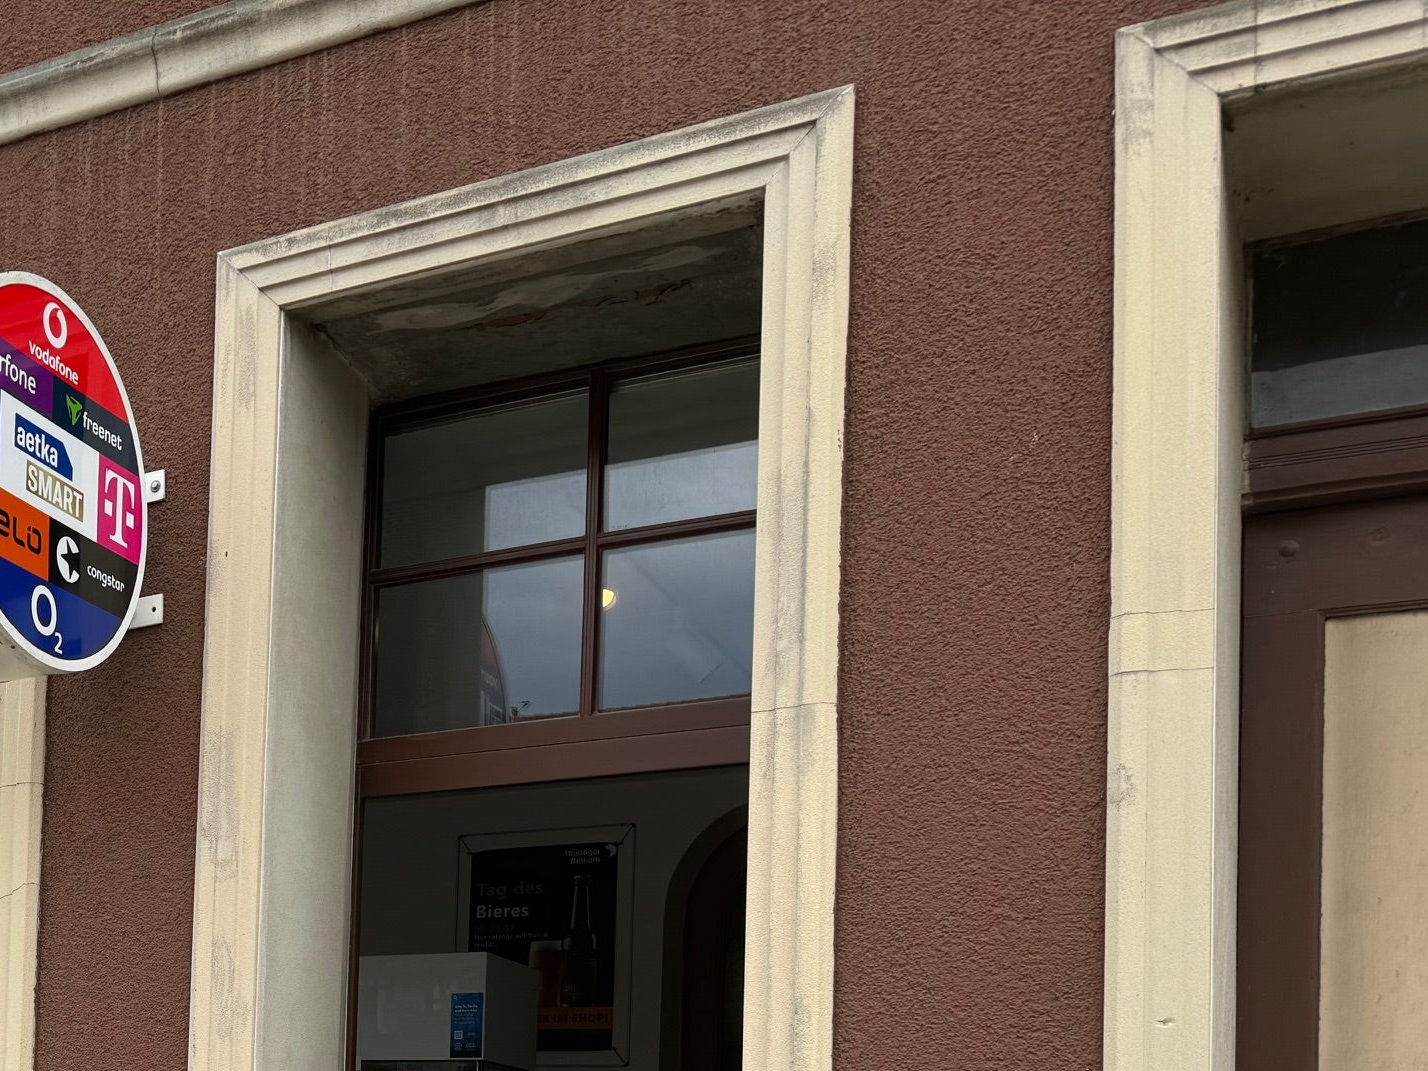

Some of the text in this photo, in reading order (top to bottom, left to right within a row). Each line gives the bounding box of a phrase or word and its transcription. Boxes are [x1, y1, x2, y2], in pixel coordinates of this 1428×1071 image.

[29, 340, 79, 385] vodafone
[17, 426, 58, 468] aetka
[83, 411, 123, 451] freenet
[28, 465, 83, 517] SMART
[104, 468, 135, 548] T
[87, 565, 125, 592] congstar
[476, 880, 543, 900] Tag des
[476, 904, 529, 919] Bieres
[553, 1013, 568, 1023] IM
[571, 1013, 608, 1023] SHOP!
